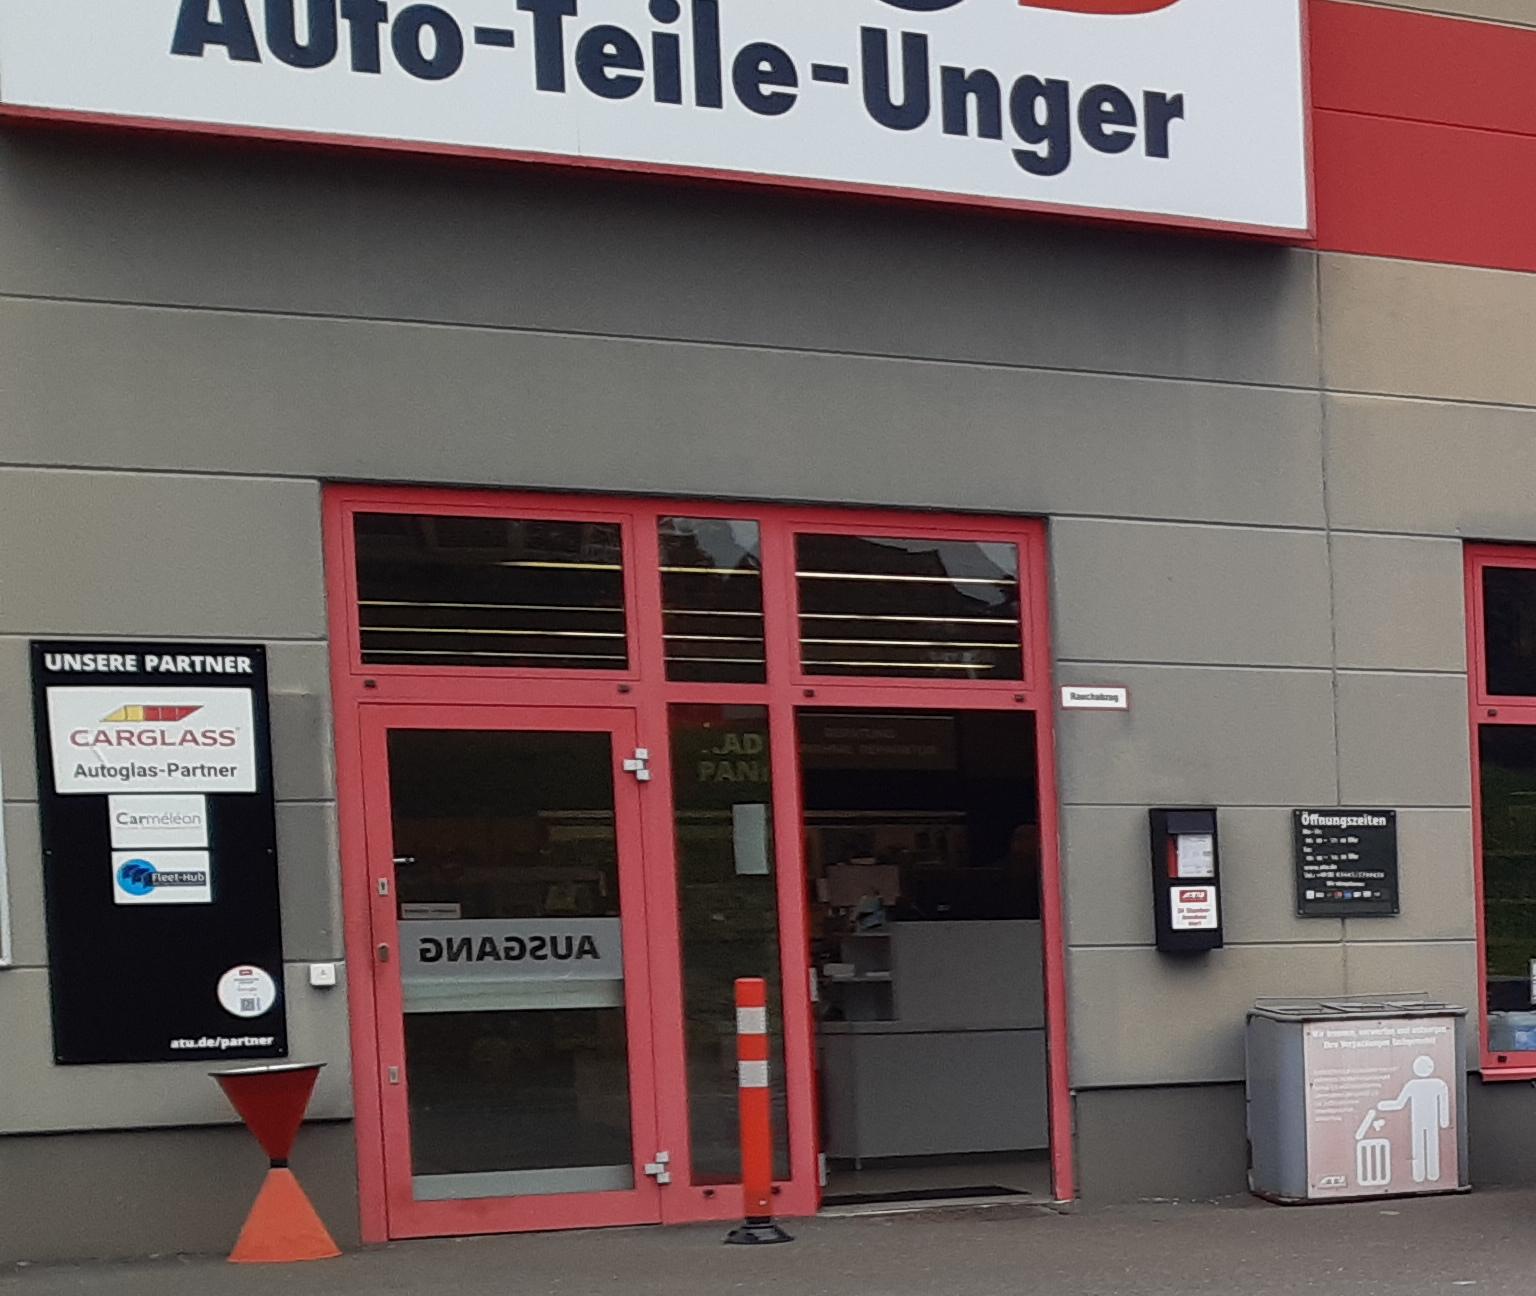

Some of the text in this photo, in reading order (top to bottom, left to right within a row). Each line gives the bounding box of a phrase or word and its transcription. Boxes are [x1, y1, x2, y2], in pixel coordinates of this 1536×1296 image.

[170, 0, 1185, 177] Auto-Teile-Unger
[44, 653, 253, 674] UNSERE PARTNER
[69, 728, 237, 747] CARGLASS
[73, 761, 238, 782] Autoglas-Partner
[1301, 811, 1387, 829] Öffnungszeiten
[152, 872, 206, 883] Fleet-Hub
[169, 1036, 274, 1050] atu.de/partner
